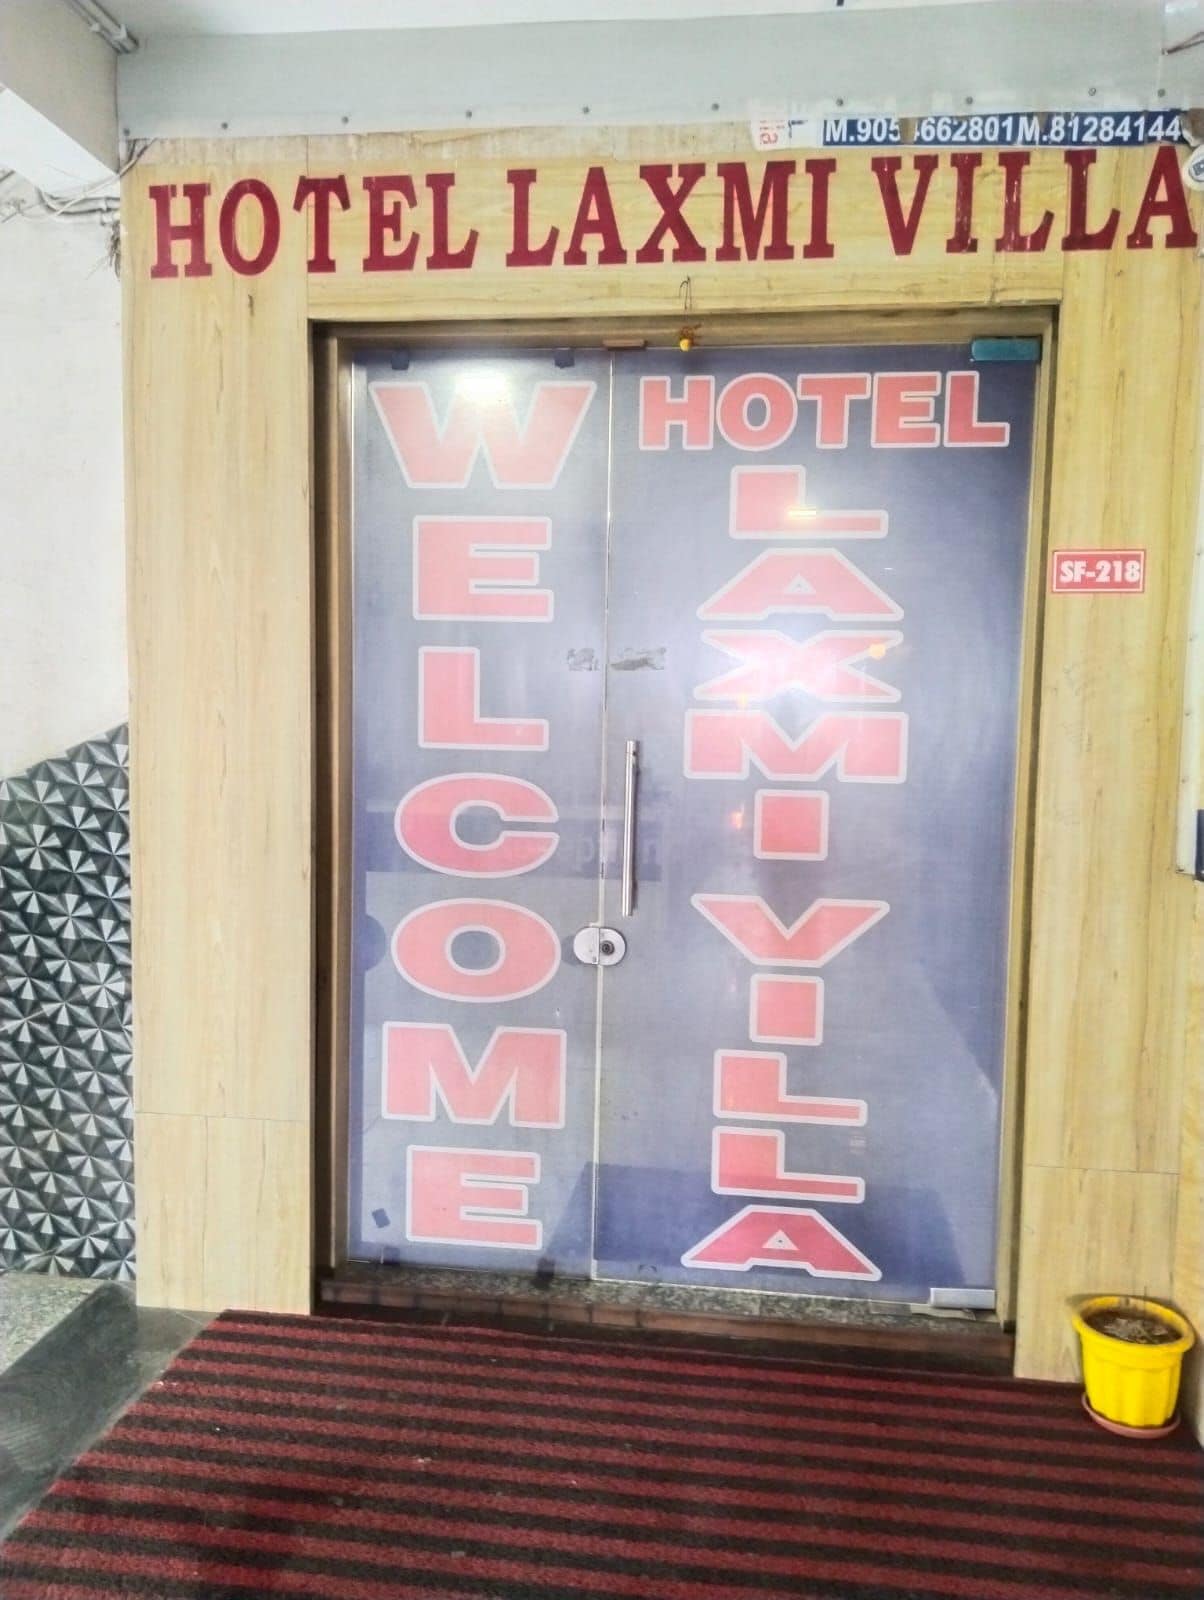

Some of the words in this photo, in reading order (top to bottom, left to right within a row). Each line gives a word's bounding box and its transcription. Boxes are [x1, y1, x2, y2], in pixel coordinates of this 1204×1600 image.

[825, 116, 1013, 143] M.905662801
[149, 172, 479, 278] HOTEL
[506, 158, 836, 267] LAXMI
[870, 146, 1198, 256] VILLA
[639, 371, 1010, 452] HOTEL
[1061, 560, 1140, 583] SF-218
[684, 465, 909, 862] LAXMI
[369, 381, 597, 1250] WELCOME
[681, 893, 891, 1281] VILLA
